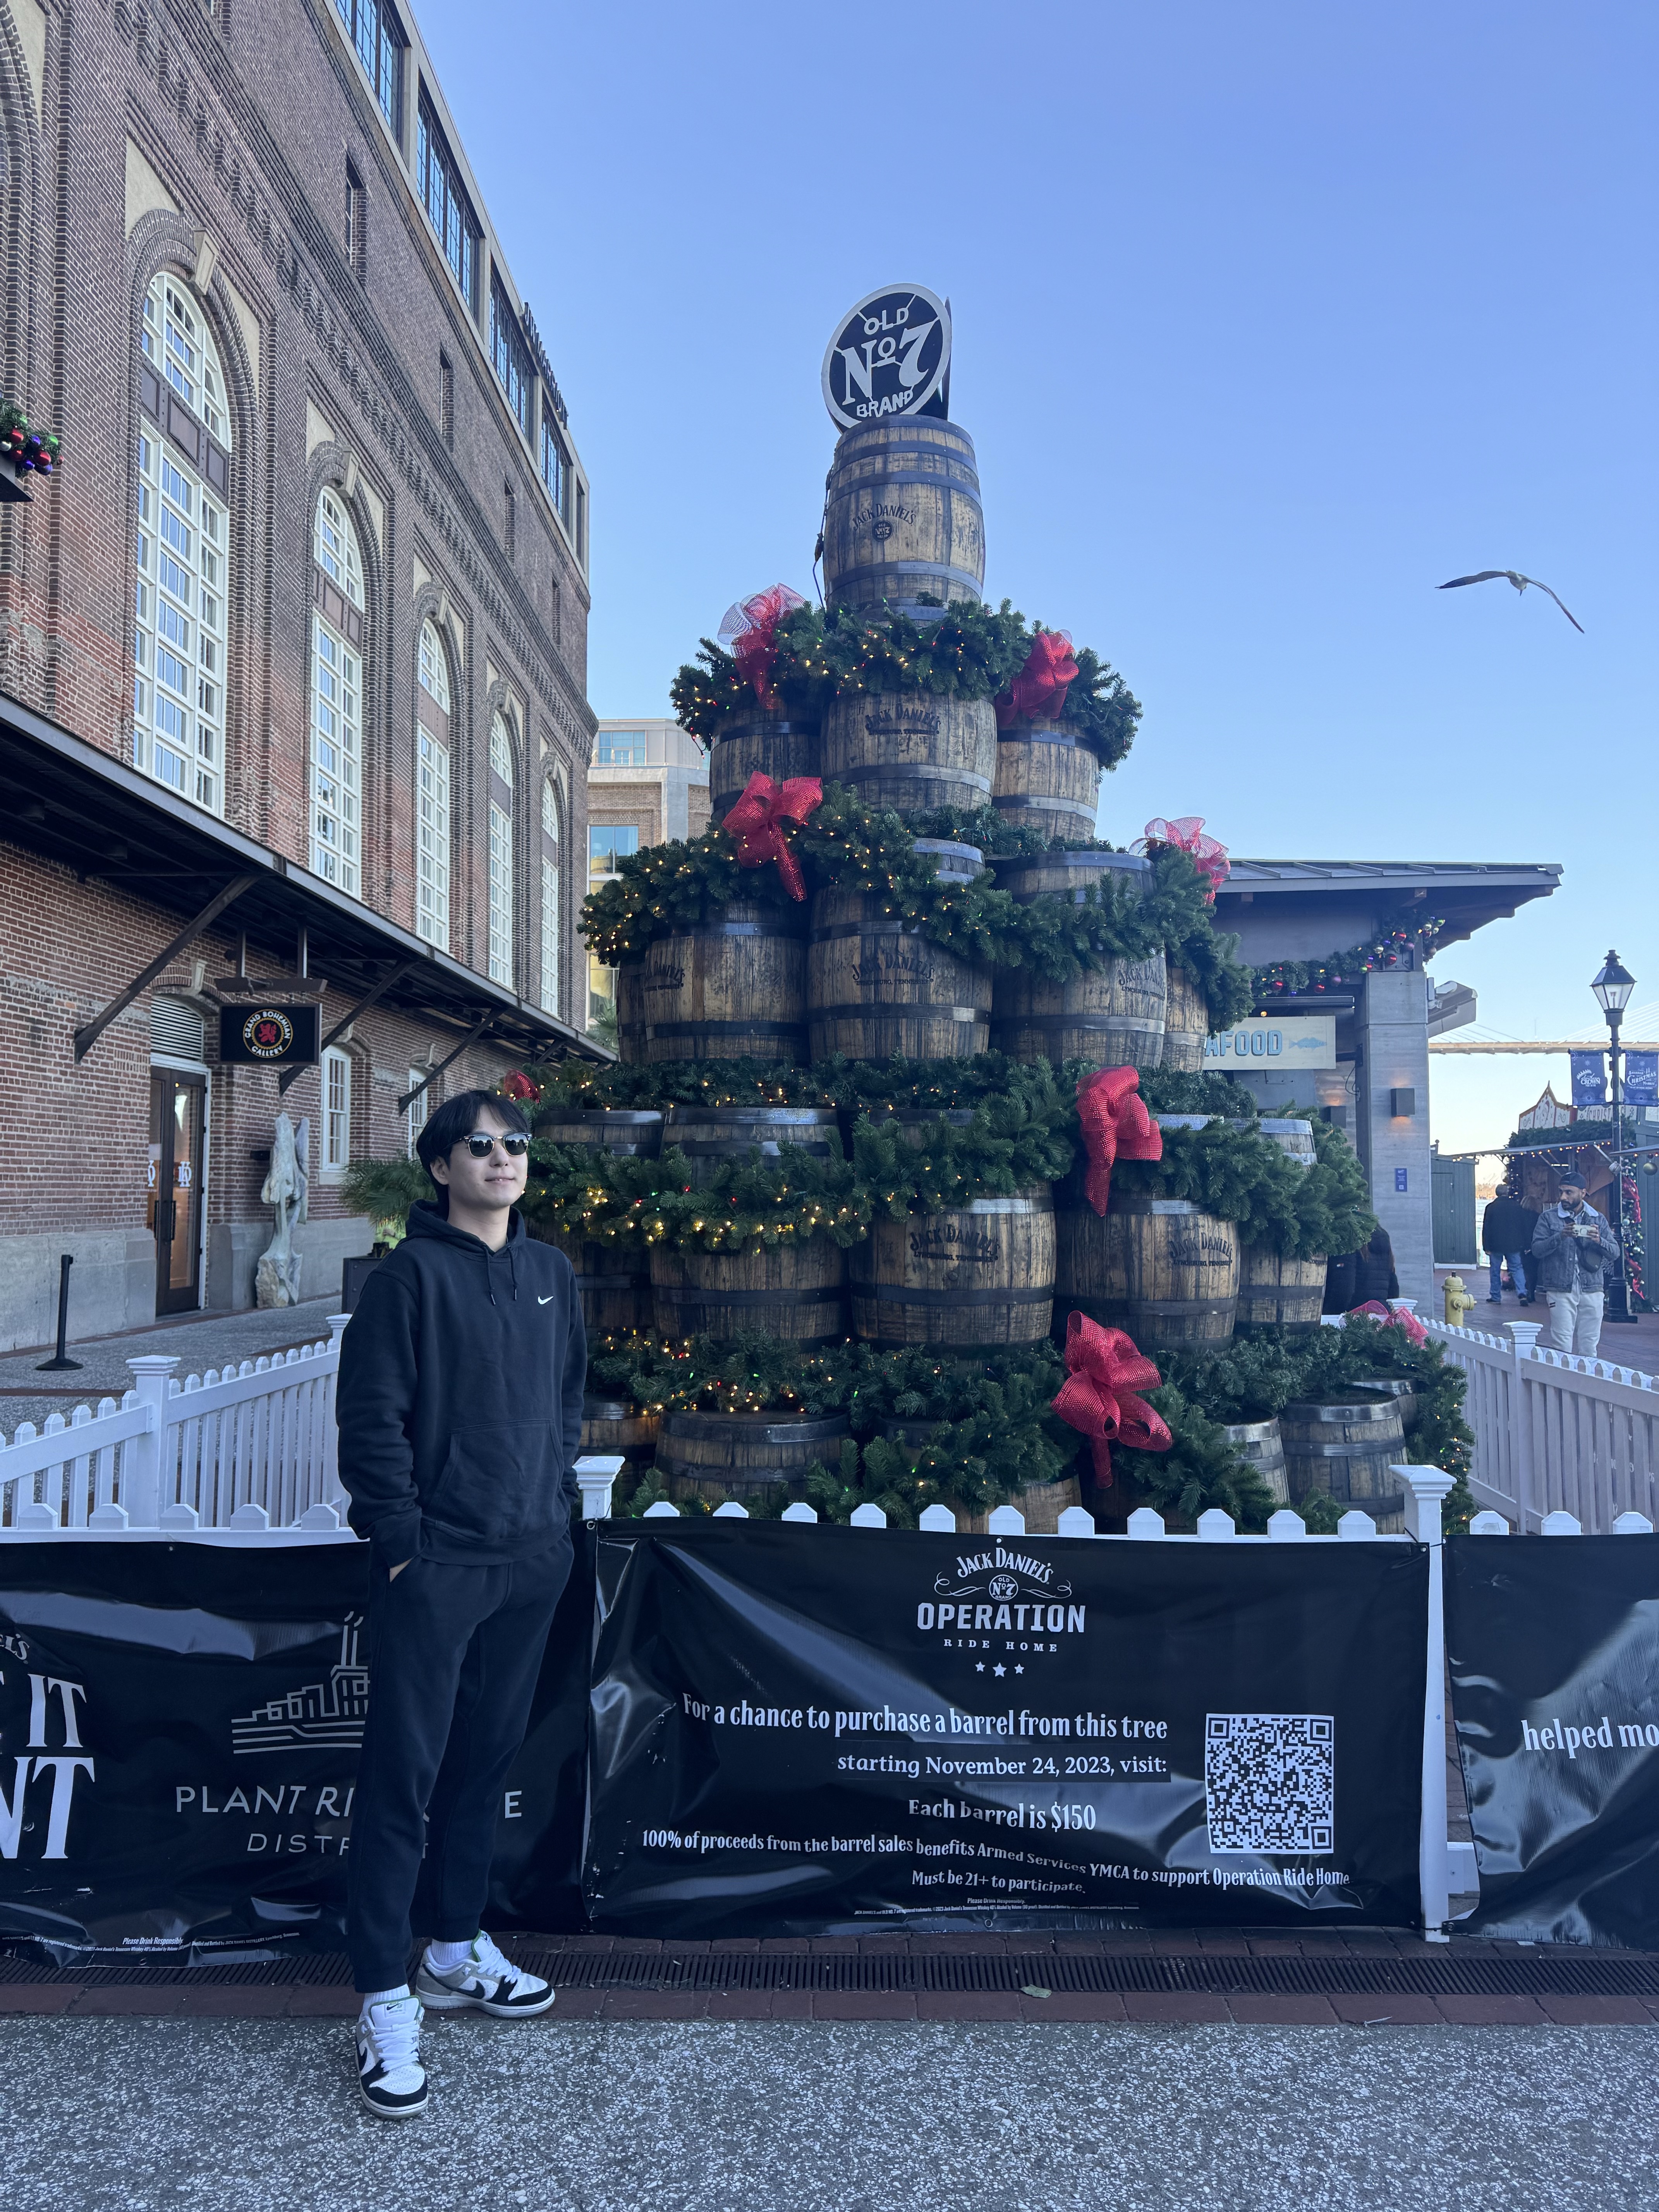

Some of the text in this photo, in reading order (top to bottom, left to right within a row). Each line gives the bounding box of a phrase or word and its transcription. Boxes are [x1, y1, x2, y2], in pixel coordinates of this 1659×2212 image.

[864, 307, 908, 335] OLD
[857, 388, 913, 417] BRAND
[853, 503, 916, 531] JACK DANIEL'S
[865, 709, 892, 731] JACK
[852, 957, 882, 981] JACK
[244, 1014, 261, 1038] GRAND
[263, 1011, 291, 1039] BOHEMIAN
[252, 1045, 283, 1056] GALLERY
[1627, 1071, 1657, 1086] CHRISTMAS
[910, 1228, 943, 1251] JACK
[1169, 1237, 1199, 1258] JACK
[956, 1547, 1054, 1583] JACK DANIEL'S
[917, 1602, 1086, 1633] OPERATION
[943, 1639, 1057, 1652] RIDE HOME
[26, 1673, 87, 1748] IT
[682, 1692, 1168, 1739] For a chance to purchase a barrel from this tree
[1520, 1716, 1614, 1759] helped
[837, 1755, 1167, 1779] starting November 24, 2023, visit:
[176, 1785, 307, 1815] PLANT
[908, 1798, 1096, 1832] Each barrel is $150
[642, 1829, 682, 1848] 100%
[684, 1830, 700, 1849] of
[701, 1834, 764, 1854] proceeds
[766, 1834, 802, 1852] from
[804, 1838, 829, 1853] the
[831, 1834, 876, 1853] barrel
[878, 1834, 913, 1852] sales
[916, 1838, 975, 1856] benefits
[977, 1843, 1024, 1862] Armed
[1027, 1853, 1086, 1874] Services
[1089, 1863, 1130, 1879] YMCA
[1133, 1867, 1149, 1881] to
[1152, 1868, 1210, 1887] support
[1212, 1867, 1280, 1891] Operation
[1283, 1867, 1314, 1886] Ride
[912, 1869, 1086, 1894] Must be 21+ to participate.
